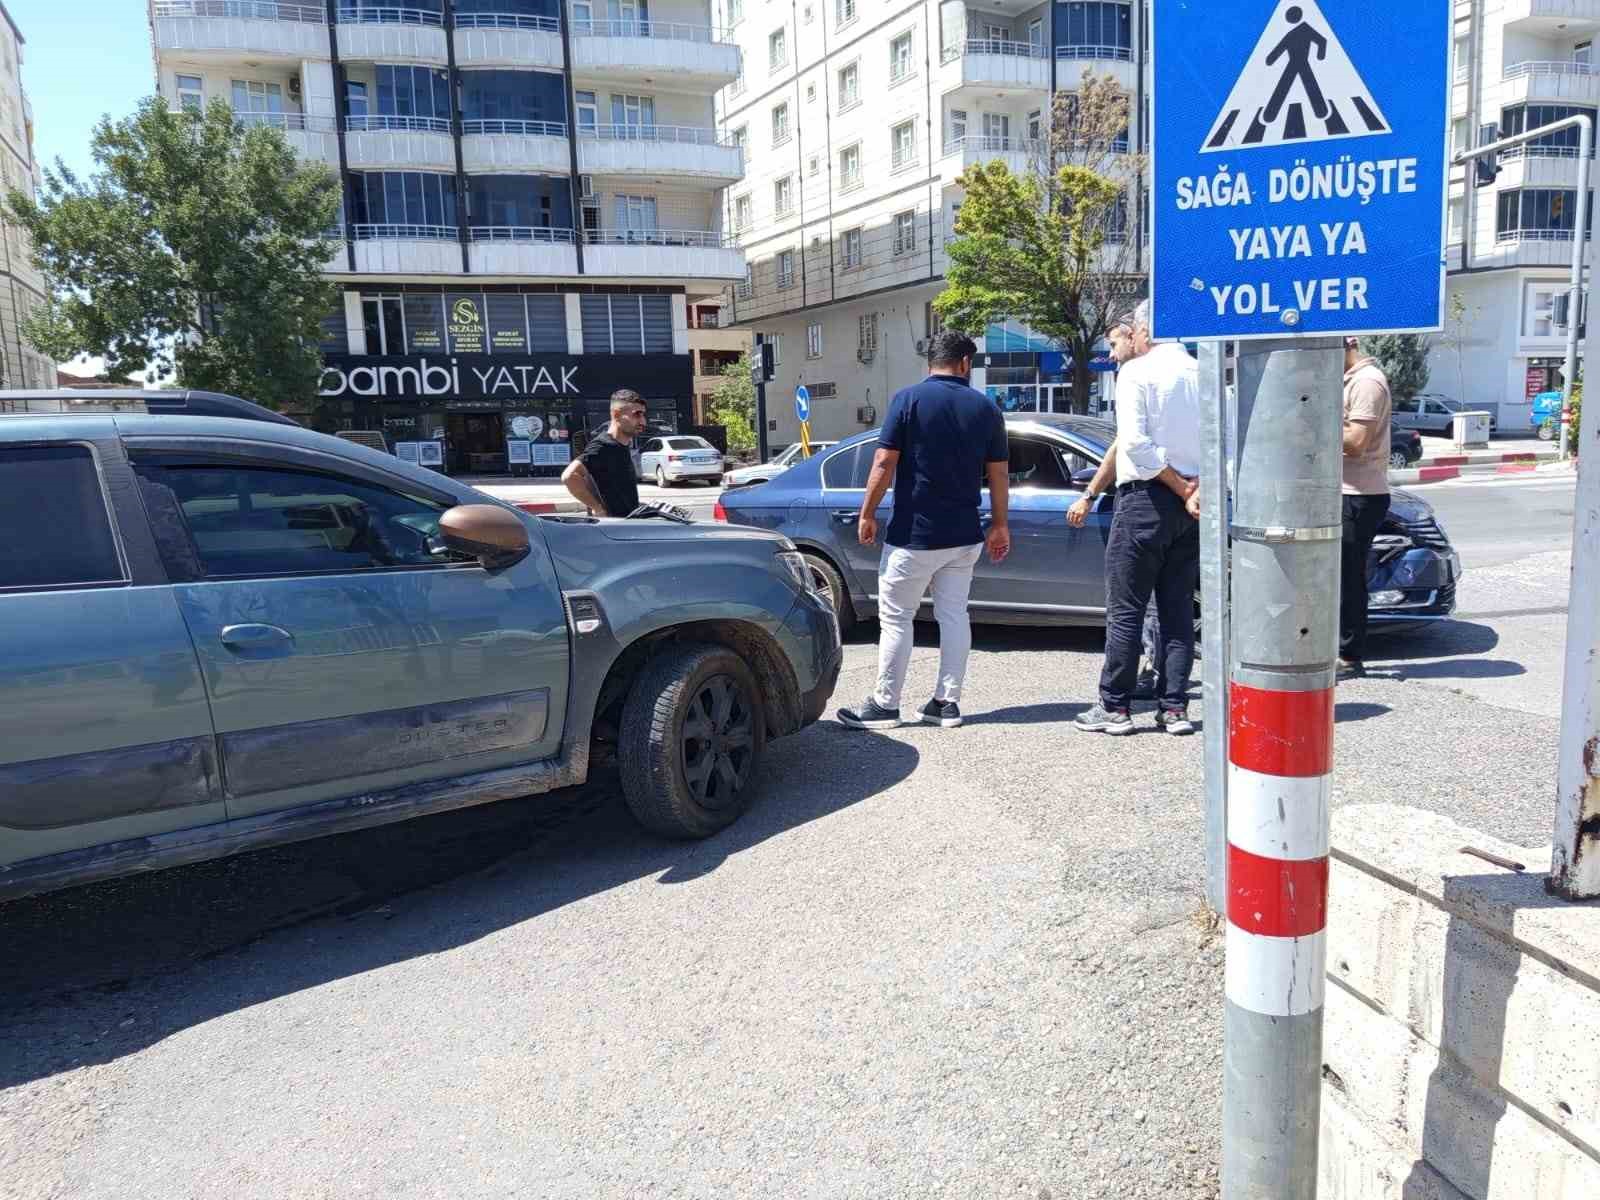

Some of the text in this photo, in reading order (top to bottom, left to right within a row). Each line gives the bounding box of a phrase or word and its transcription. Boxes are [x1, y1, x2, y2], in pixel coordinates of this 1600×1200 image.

[1176, 155, 1417, 210] SAĞA DÖNÜŞTE
[1228, 221, 1368, 261] YAYA YA
[1210, 277, 1369, 316] YOL VER
[472, 365, 580, 395] YATAK
